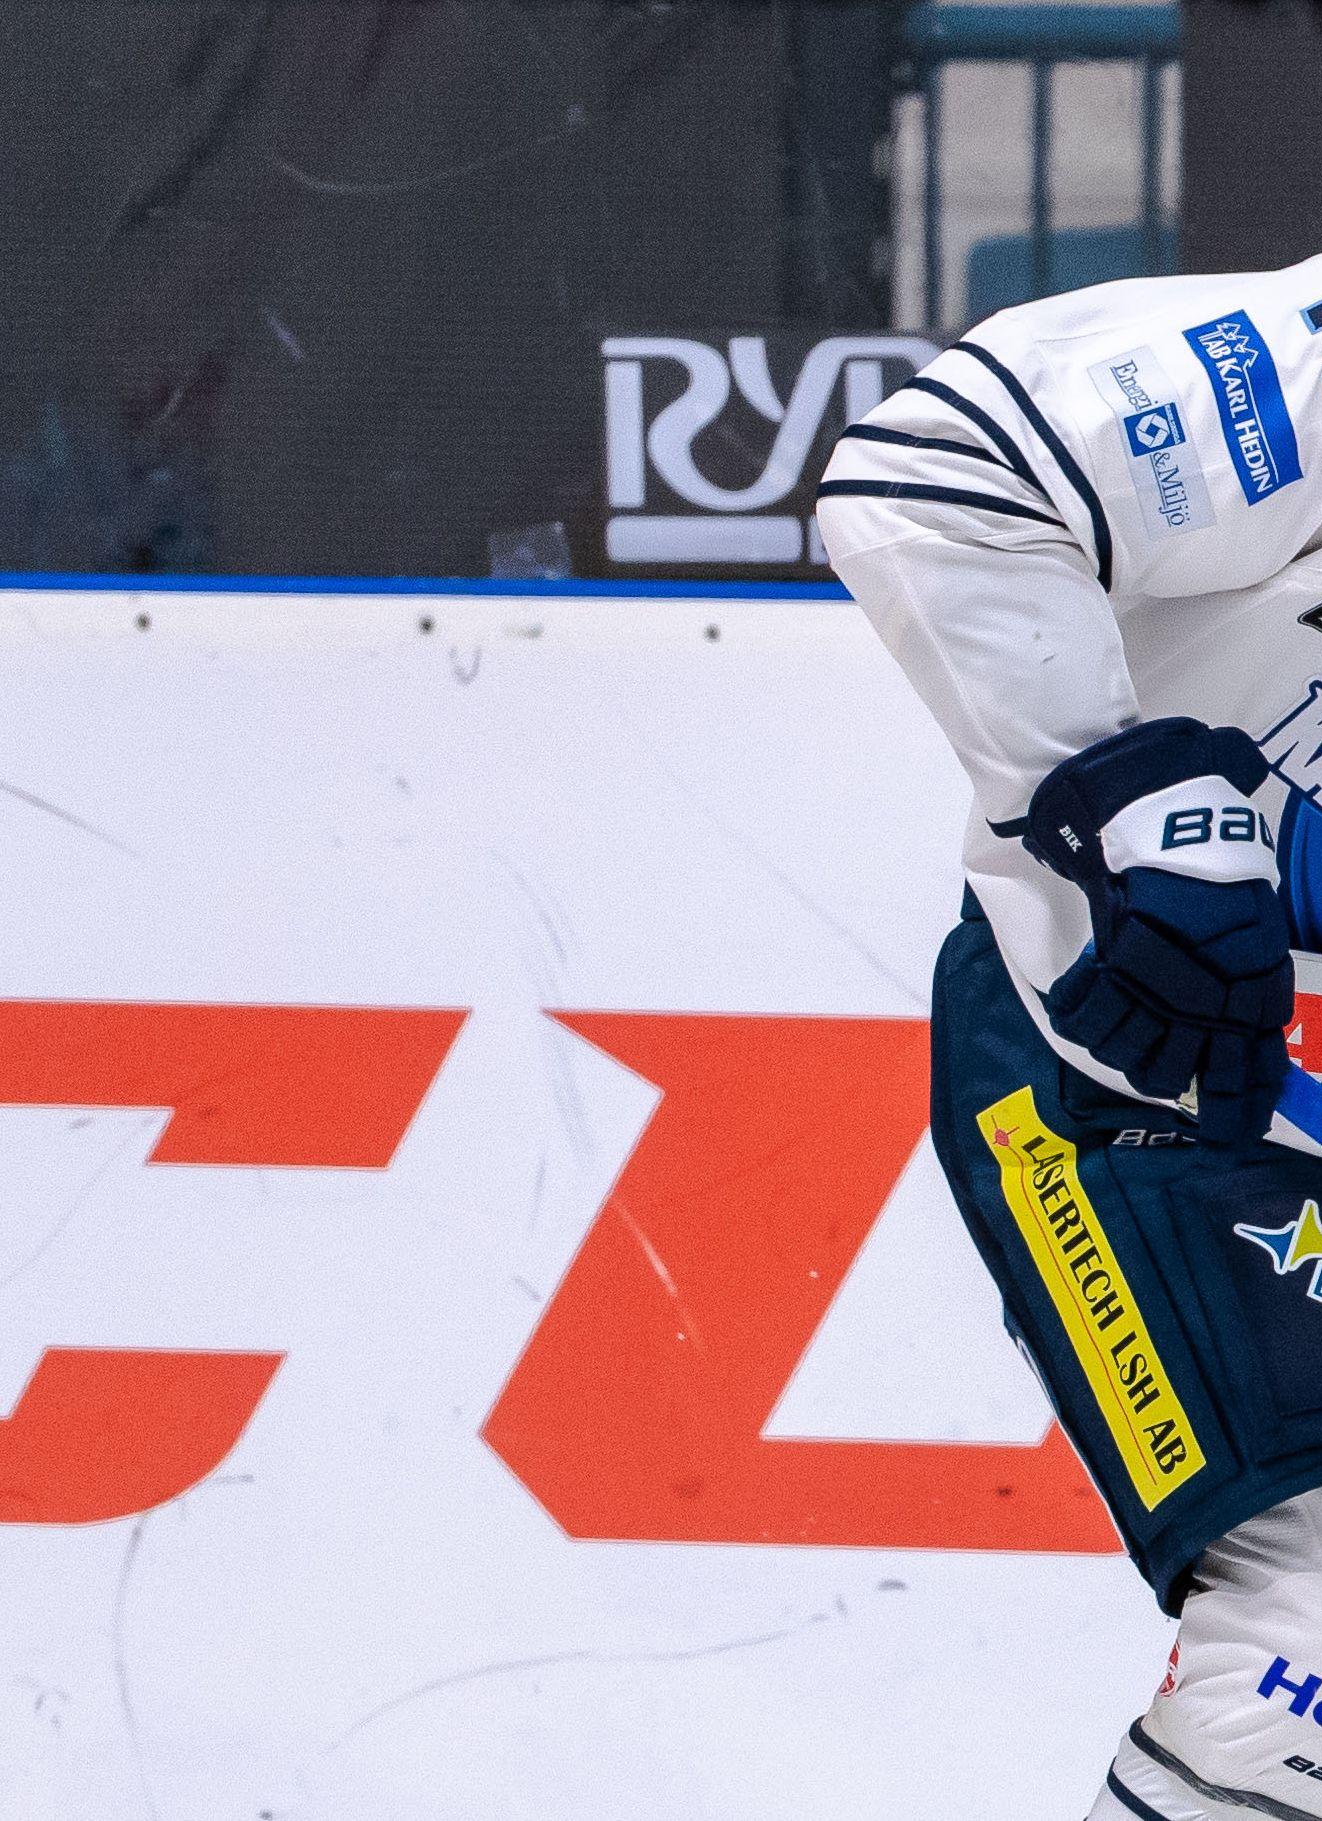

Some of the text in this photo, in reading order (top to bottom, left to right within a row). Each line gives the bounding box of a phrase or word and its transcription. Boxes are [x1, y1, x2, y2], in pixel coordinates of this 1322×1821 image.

[1215, 362, 1248, 419] KARL
[1234, 419, 1273, 493] HEDIN
[1058, 814, 1083, 852] BIK
[1022, 1135, 1187, 1475] LASERTECH LSH AB
